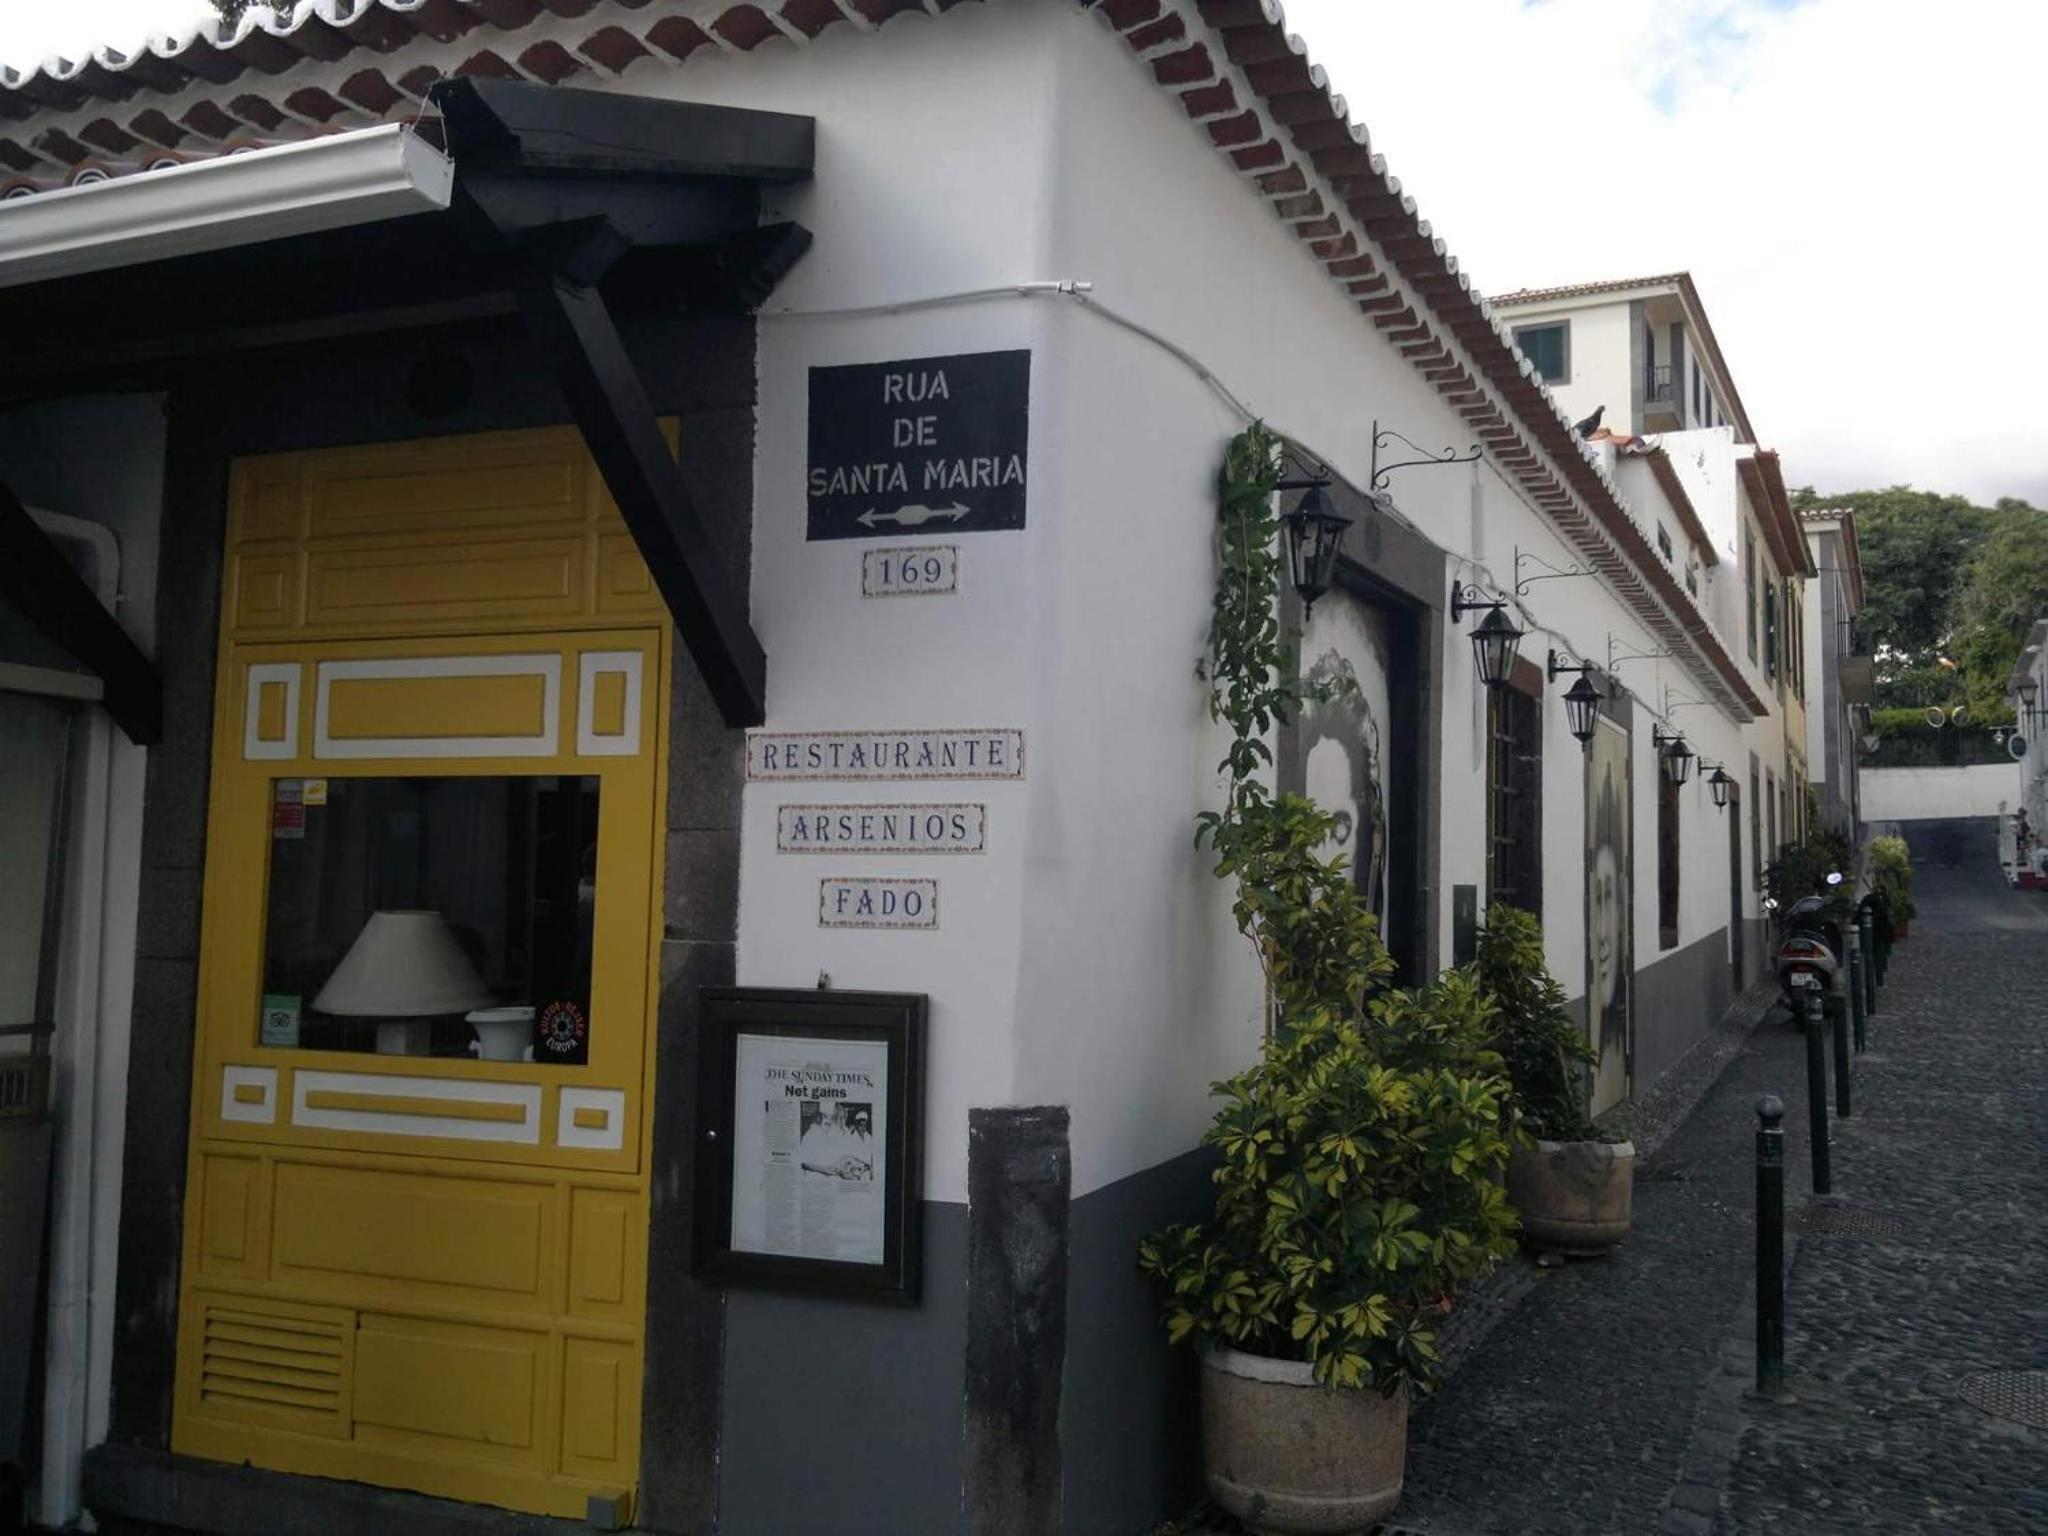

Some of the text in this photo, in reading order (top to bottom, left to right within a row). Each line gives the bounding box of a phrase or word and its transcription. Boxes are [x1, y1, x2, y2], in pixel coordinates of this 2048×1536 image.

[884, 369, 949, 404] RUA
[893, 415, 938, 448] DE
[809, 453, 1025, 496] SANTA MARIA
[879, 554, 942, 585] 169
[763, 739, 1004, 770] RESTAURANTE
[791, 814, 966, 842] ARSENIOS
[836, 889, 922, 917] FADO
[785, 1085, 848, 1100] Net gains
[791, 1070, 833, 1083] SUNDAY
[836, 1073, 873, 1087] TIMES
